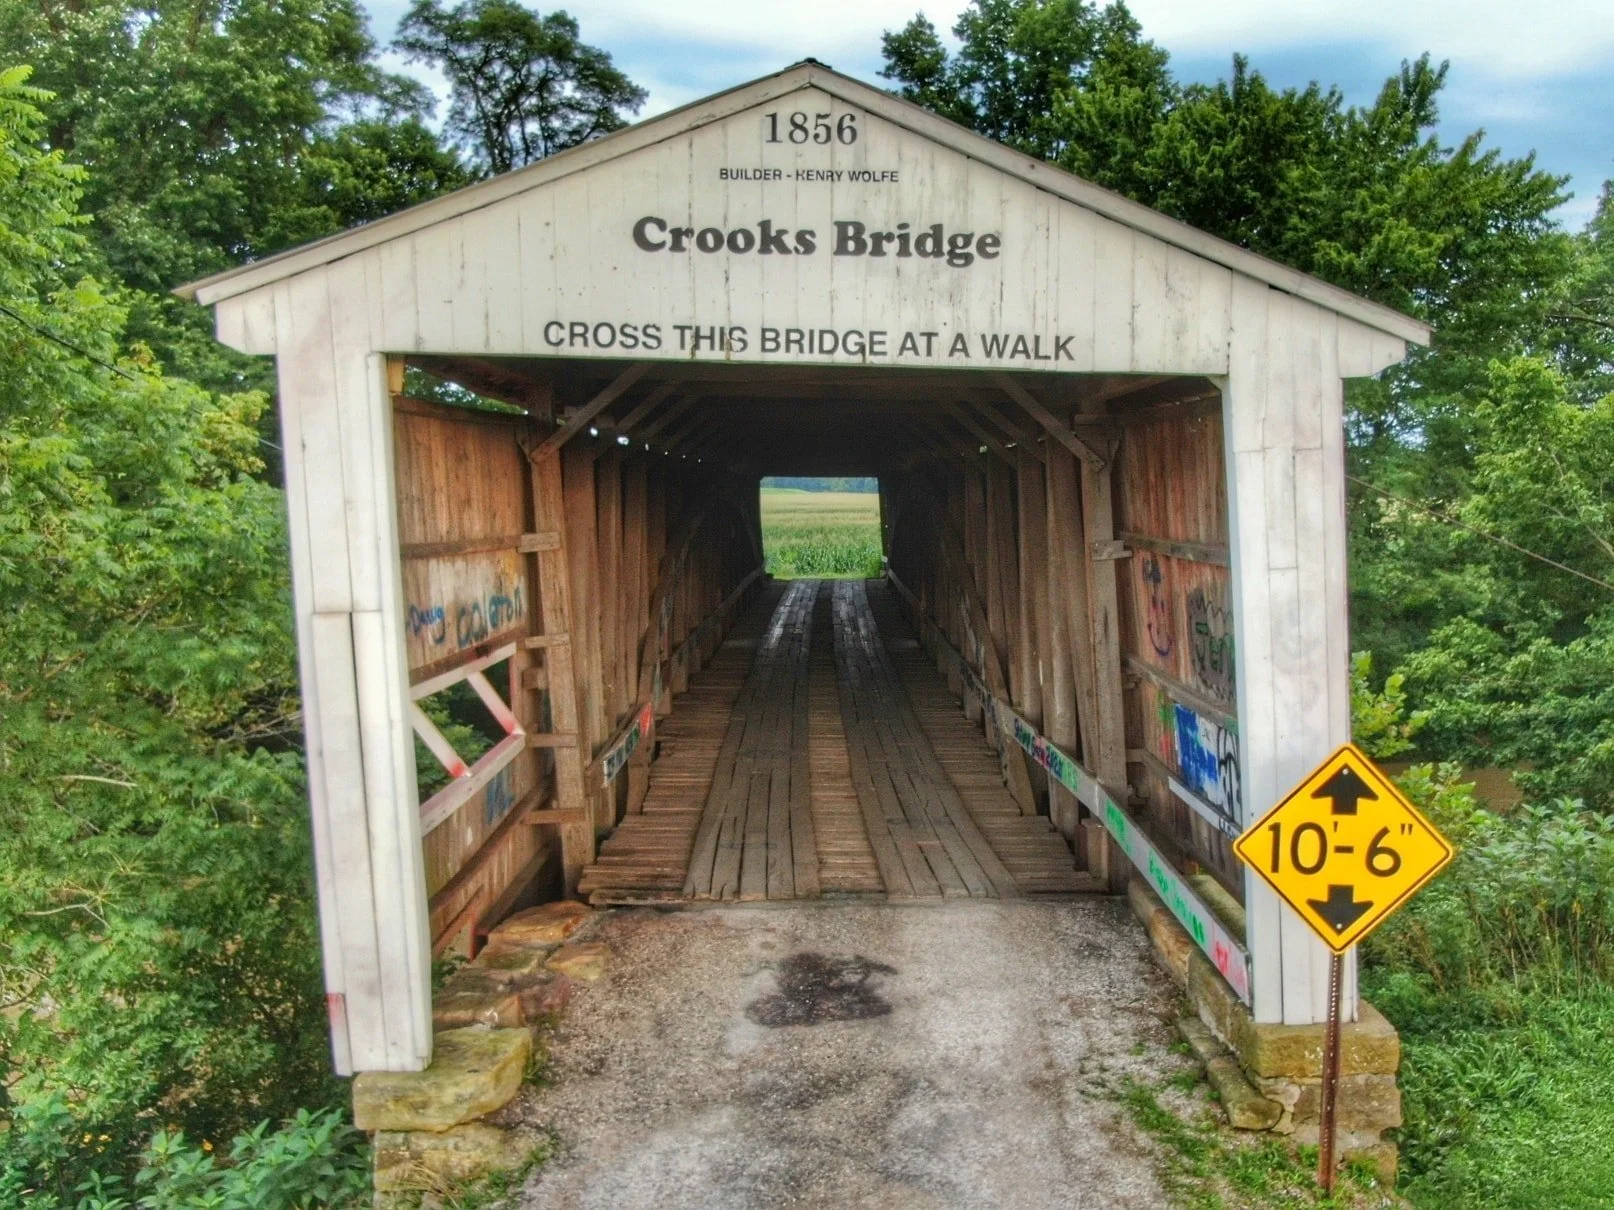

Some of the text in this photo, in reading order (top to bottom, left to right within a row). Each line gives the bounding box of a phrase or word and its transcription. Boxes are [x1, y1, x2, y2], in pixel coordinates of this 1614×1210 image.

[764, 111, 858, 146] 1856
[719, 168, 782, 181] BUILDER
[848, 170, 899, 183] WOLFE
[632, 215, 1001, 268] Crooks Bridge
[543, 321, 1075, 361] CROSS THIS BRIDGE AT A WALK
